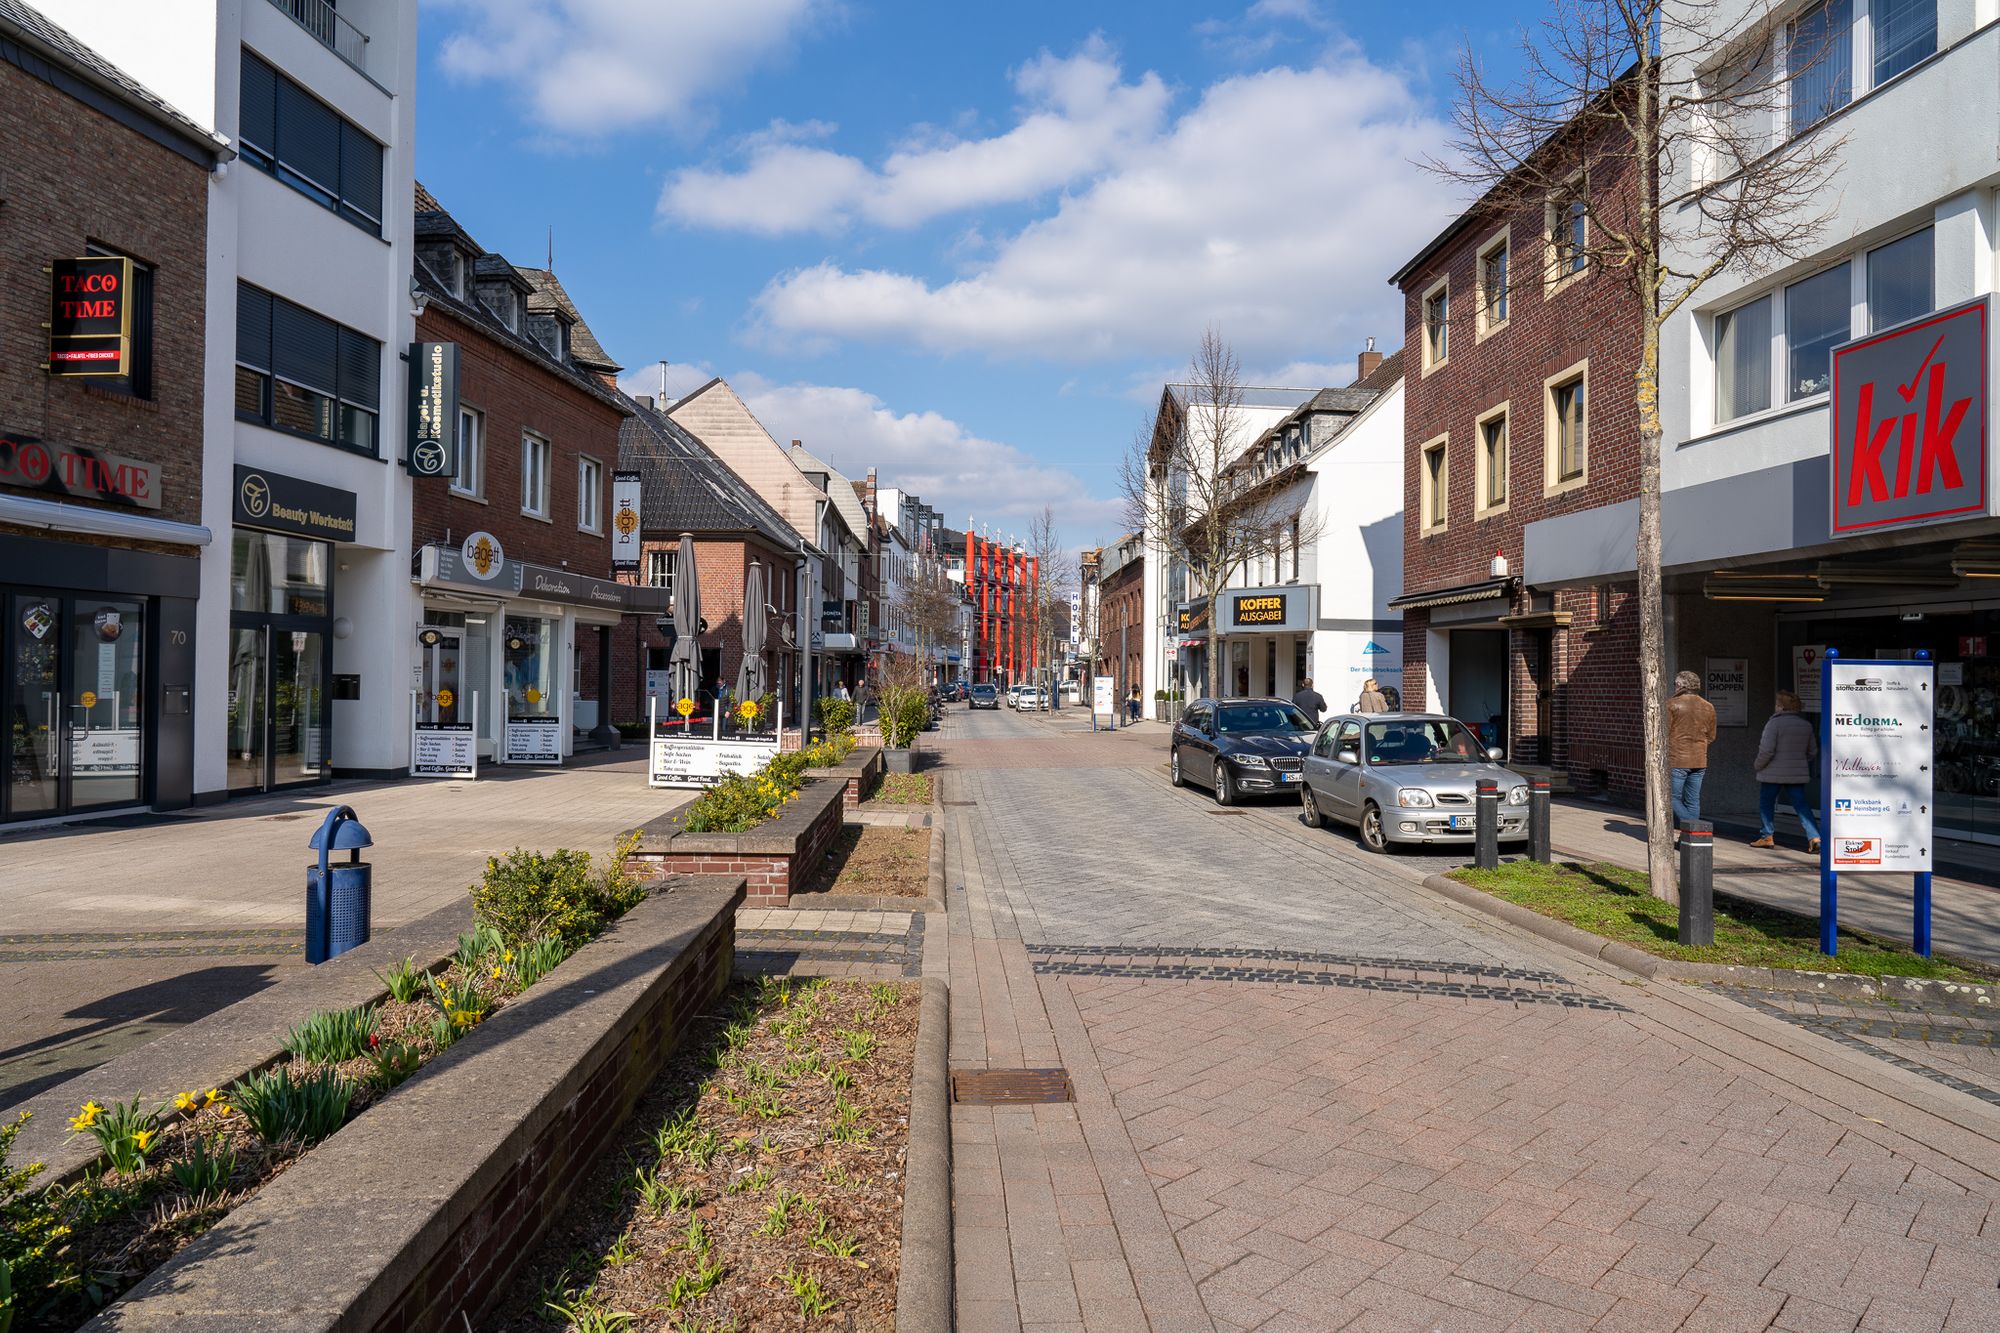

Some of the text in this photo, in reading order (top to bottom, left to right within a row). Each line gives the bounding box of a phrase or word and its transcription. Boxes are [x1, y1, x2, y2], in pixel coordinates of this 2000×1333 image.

[61, 274, 118, 293] TACO
[61, 300, 116, 318] TIME
[60, 452, 149, 499] TIME
[272, 503, 308, 525] Beauty
[619, 498, 634, 544] bagett
[466, 539, 500, 568] bagett
[1240, 598, 1281, 610] KOFFER
[171, 631, 187, 645] 70
[1708, 673, 1744, 683] ONLINE
[1708, 683, 1744, 692] SHOPPEN
[1456, 817, 1467, 826] HS
